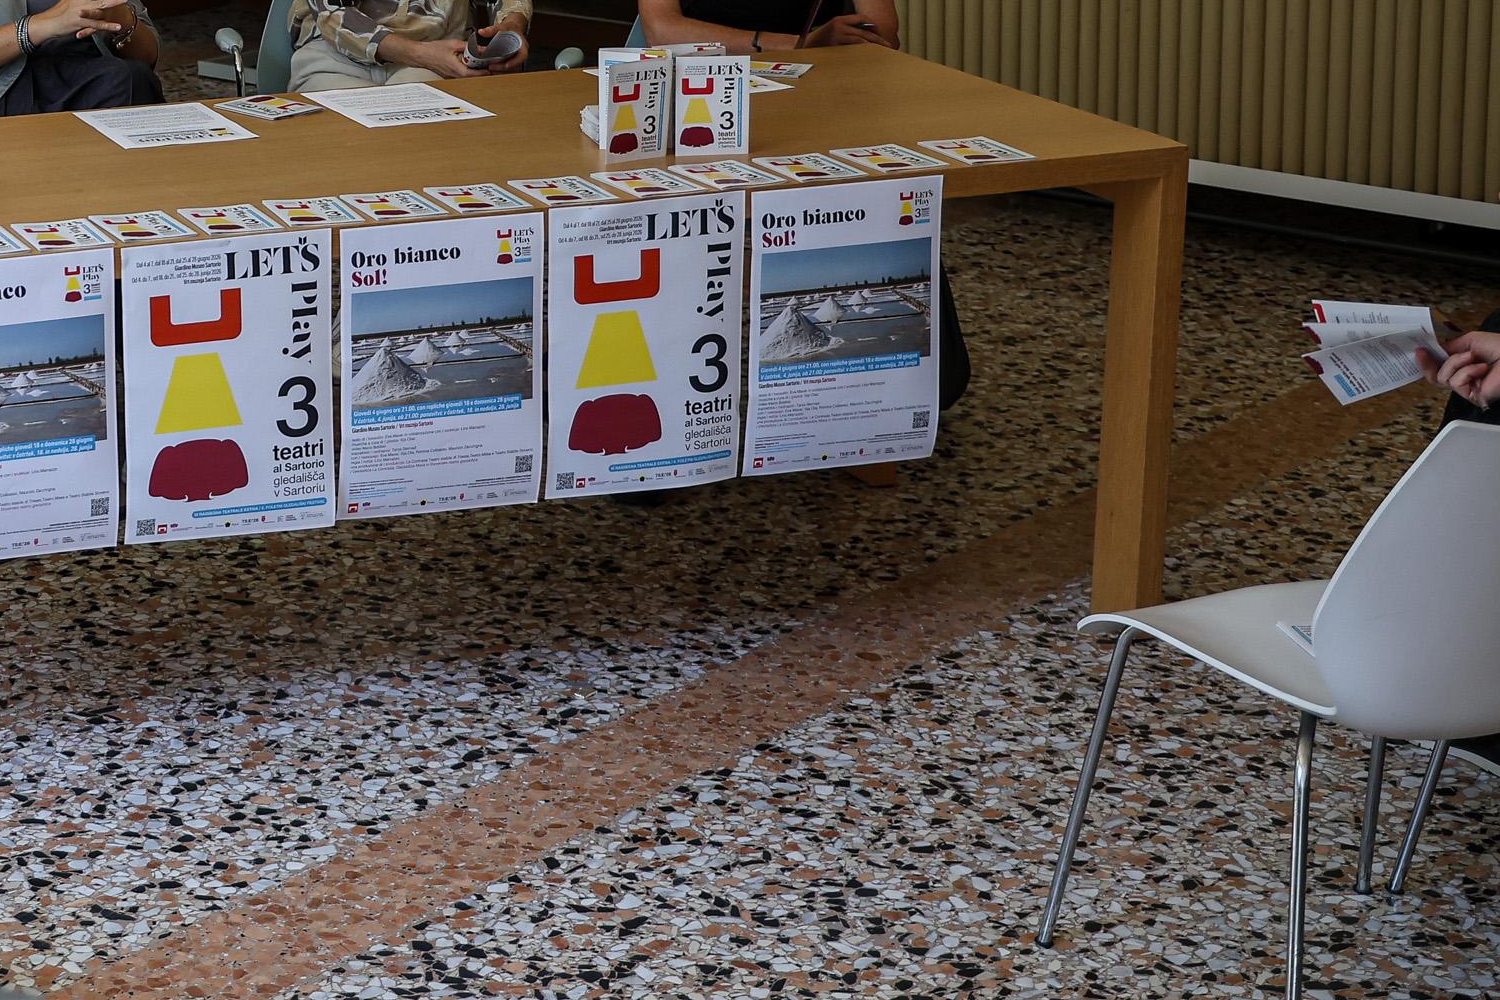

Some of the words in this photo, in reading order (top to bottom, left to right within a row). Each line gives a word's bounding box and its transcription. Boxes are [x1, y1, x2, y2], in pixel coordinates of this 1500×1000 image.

[645, 82, 659, 109] Play
[720, 77, 735, 105] Play
[643, 115, 656, 135] 3
[719, 111, 734, 130] 3
[641, 134, 657, 142] teatri
[762, 212, 796, 230] Oro
[802, 206, 866, 226] bianco
[915, 208, 921, 218] 3
[514, 236, 530, 244] Play
[762, 230, 796, 249] Sol!
[351, 250, 387, 268] Oro
[394, 243, 461, 264] bianco
[514, 246, 522, 257] 3
[83, 273, 100, 282] Play
[351, 269, 388, 288] Sol!
[697, 241, 732, 323] Play
[83, 283, 91, 294] 3
[282, 280, 318, 364] Play
[689, 333, 729, 393] 3
[276, 375, 319, 438] 3
[684, 393, 732, 416] teatri
[684, 418, 693, 428] al
[695, 413, 732, 426] Sartorio
[684, 425, 731, 442] gledališča
[272, 438, 324, 461] teatri
[685, 443, 691, 451] v
[693, 436, 731, 450] Sartoriu
[273, 463, 282, 473] al
[284, 459, 325, 472] Sartorio
[273, 471, 325, 488] gledališča
[274, 489, 280, 497] v
[283, 483, 325, 497] Sartoriu
